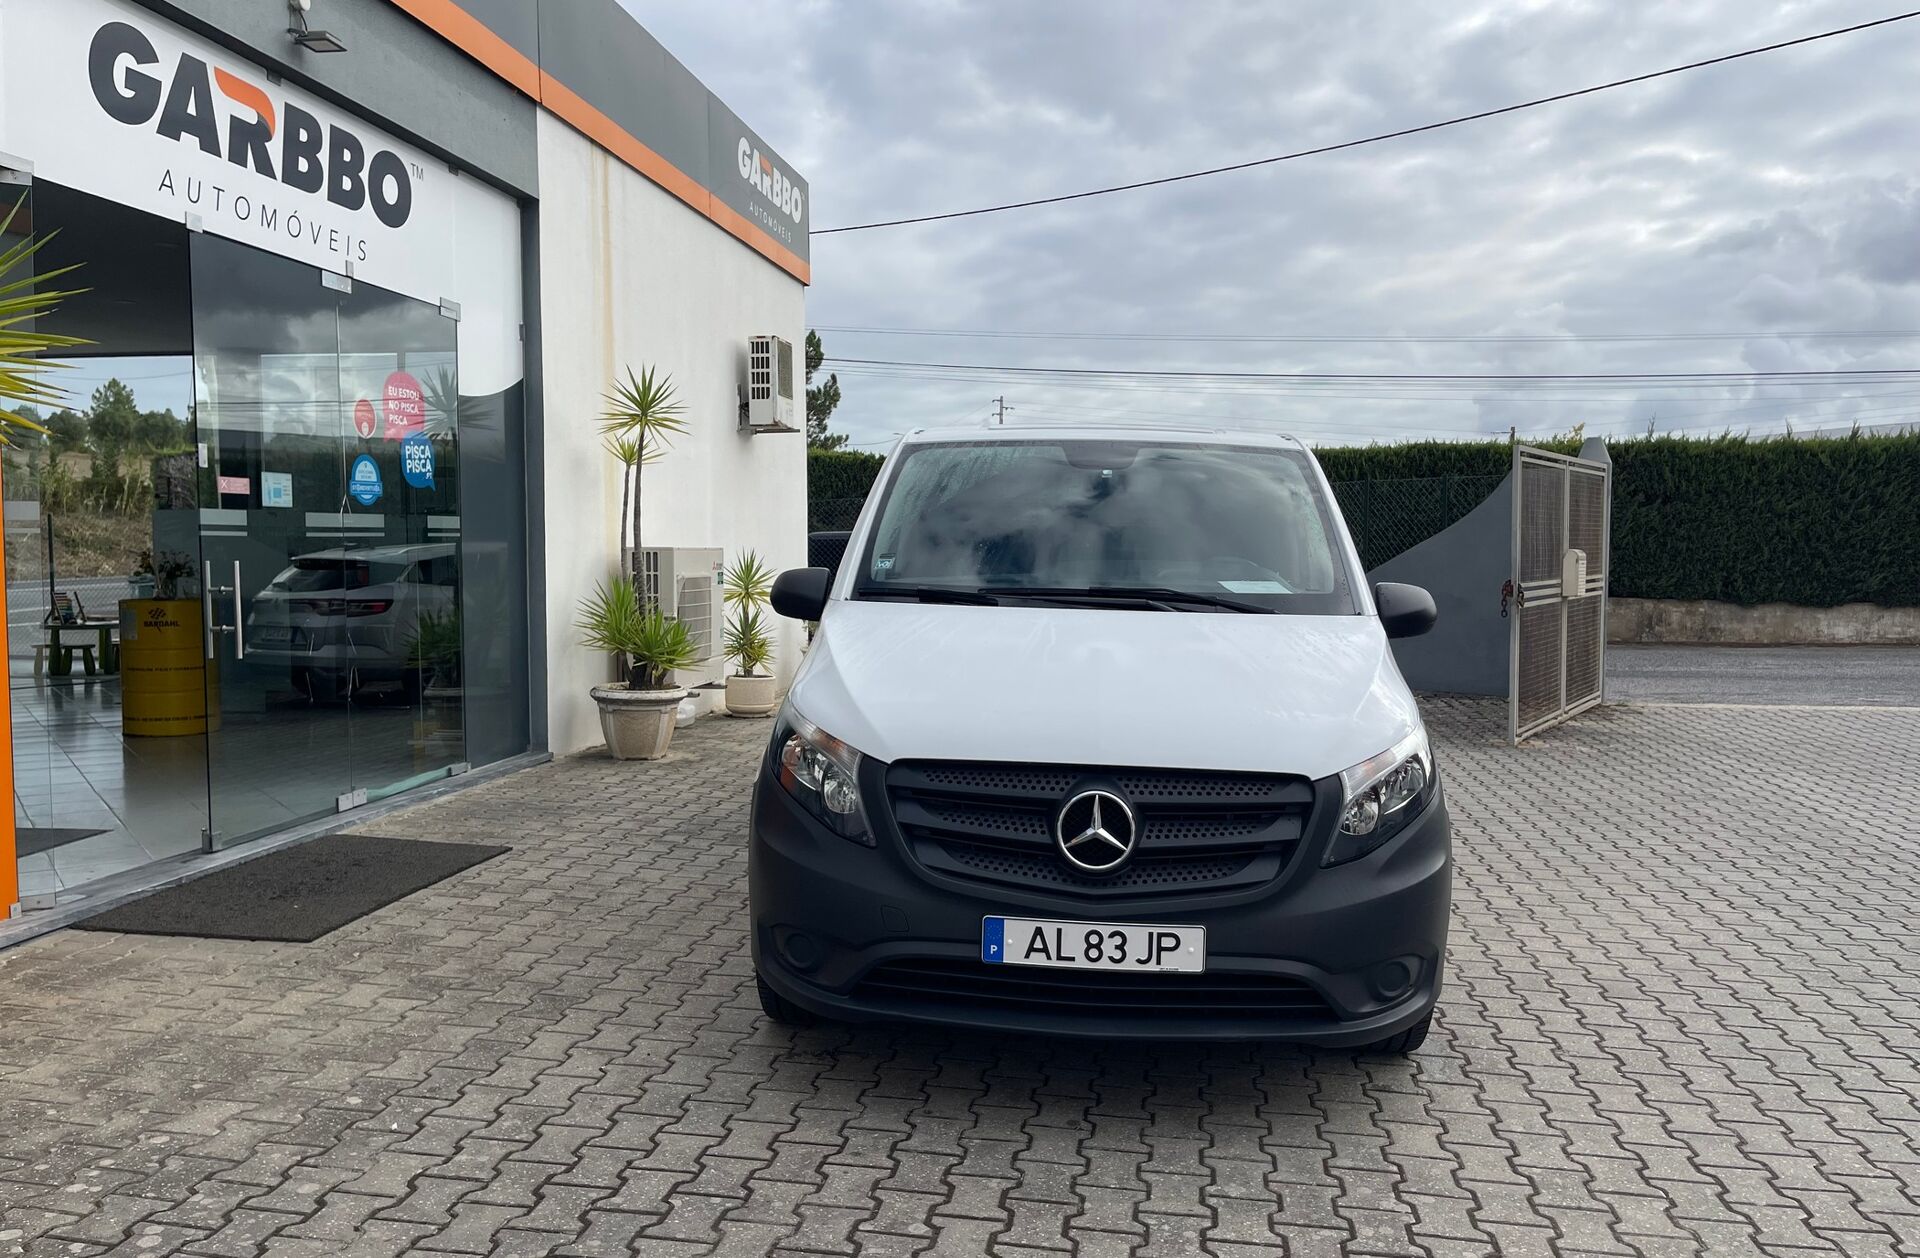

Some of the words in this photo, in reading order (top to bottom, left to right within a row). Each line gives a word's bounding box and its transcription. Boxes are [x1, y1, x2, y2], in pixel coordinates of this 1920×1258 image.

[88, 21, 412, 229] GARBBO
[738, 137, 802, 224] GARBBO
[158, 169, 367, 261] AUTOMÓVEIS
[388, 385, 398, 396] EU
[399, 387, 420, 401] ESTOU
[388, 400, 400, 411] NO
[400, 402, 420, 415] PISCA
[389, 414, 408, 426] PISCA
[990, 944, 998, 955] P
[1023, 926, 1076, 962] AL
[1083, 929, 1128, 964] 83
[1135, 931, 1181, 966] JP
